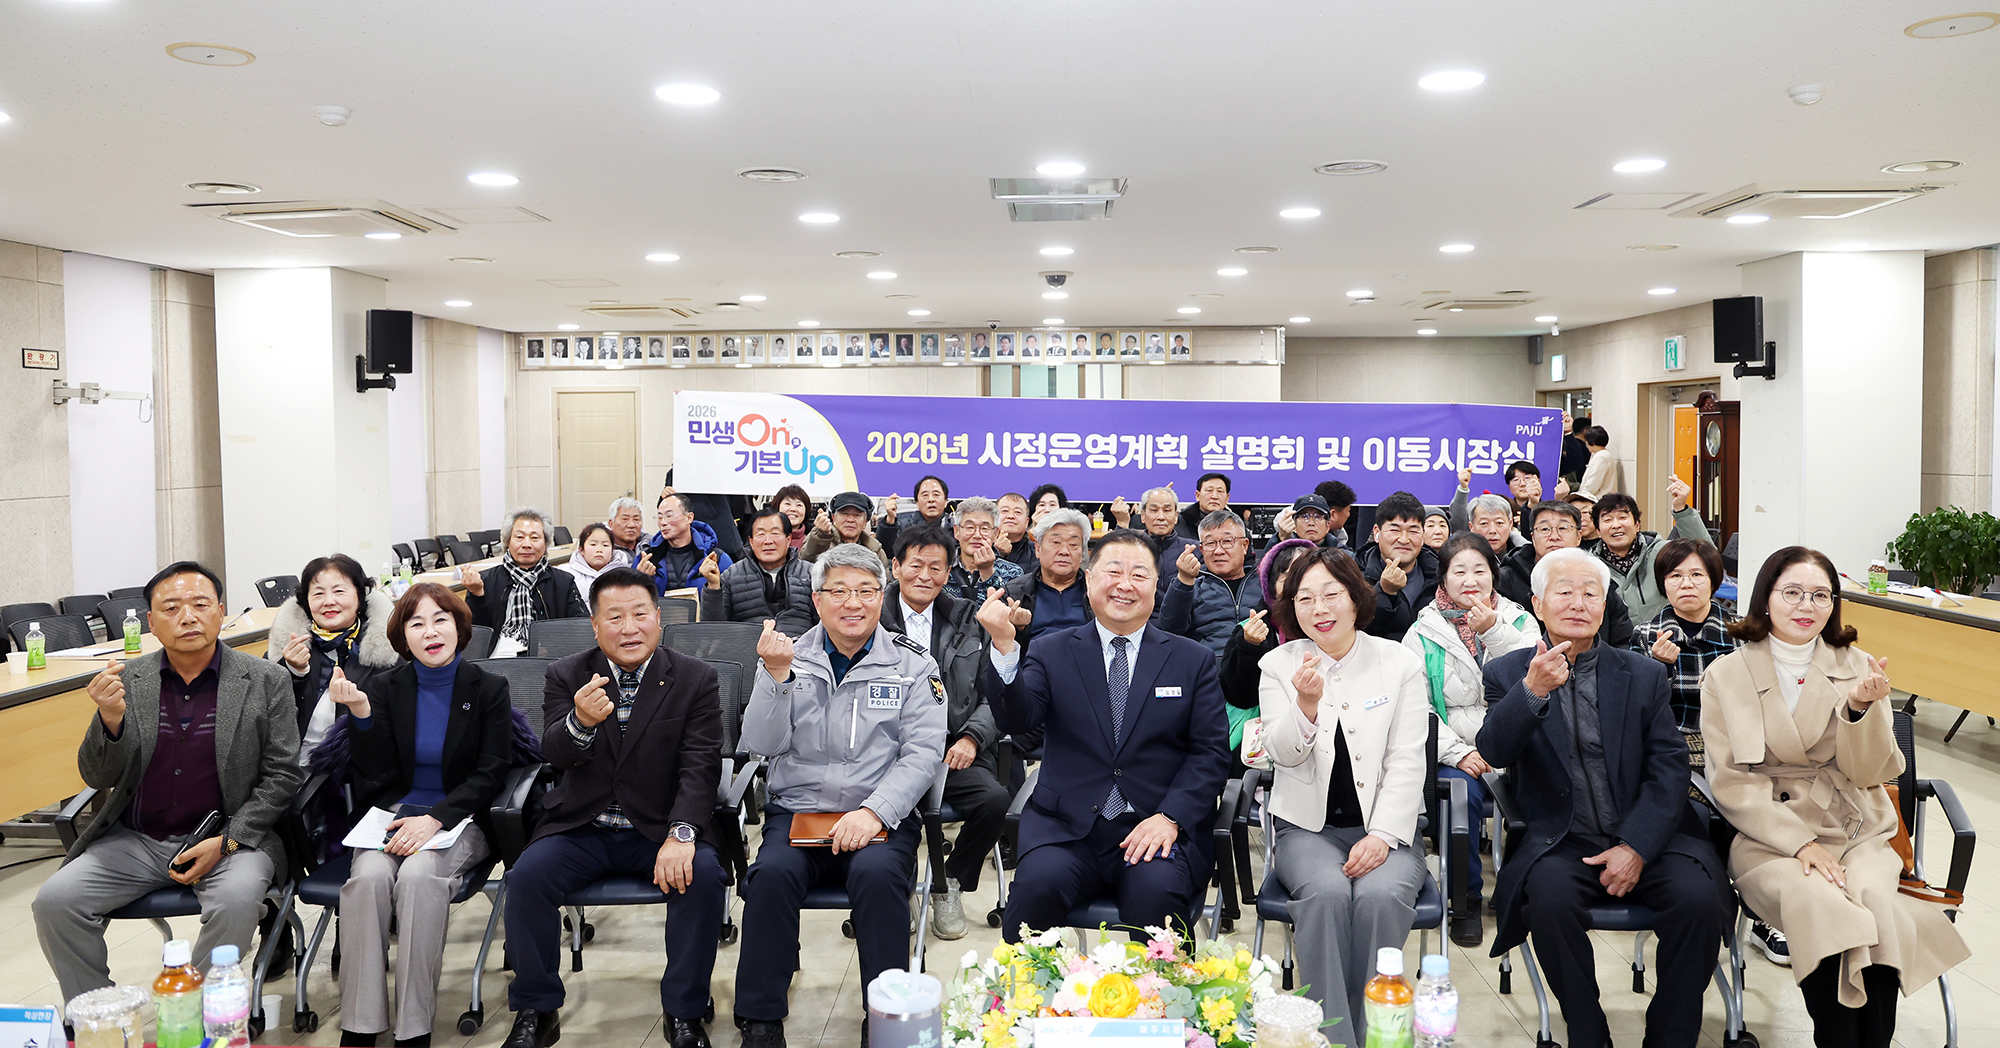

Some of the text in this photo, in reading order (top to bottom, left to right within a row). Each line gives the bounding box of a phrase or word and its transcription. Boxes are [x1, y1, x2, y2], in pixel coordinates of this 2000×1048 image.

[688, 405, 717, 418] 2026
[1515, 424, 1543, 438] PAJU
[866, 431, 969, 465] 2026년
[977, 431, 1189, 470] 시정운영계획
[1200, 435, 1305, 471] 설명회
[1317, 436, 1351, 471] 및
